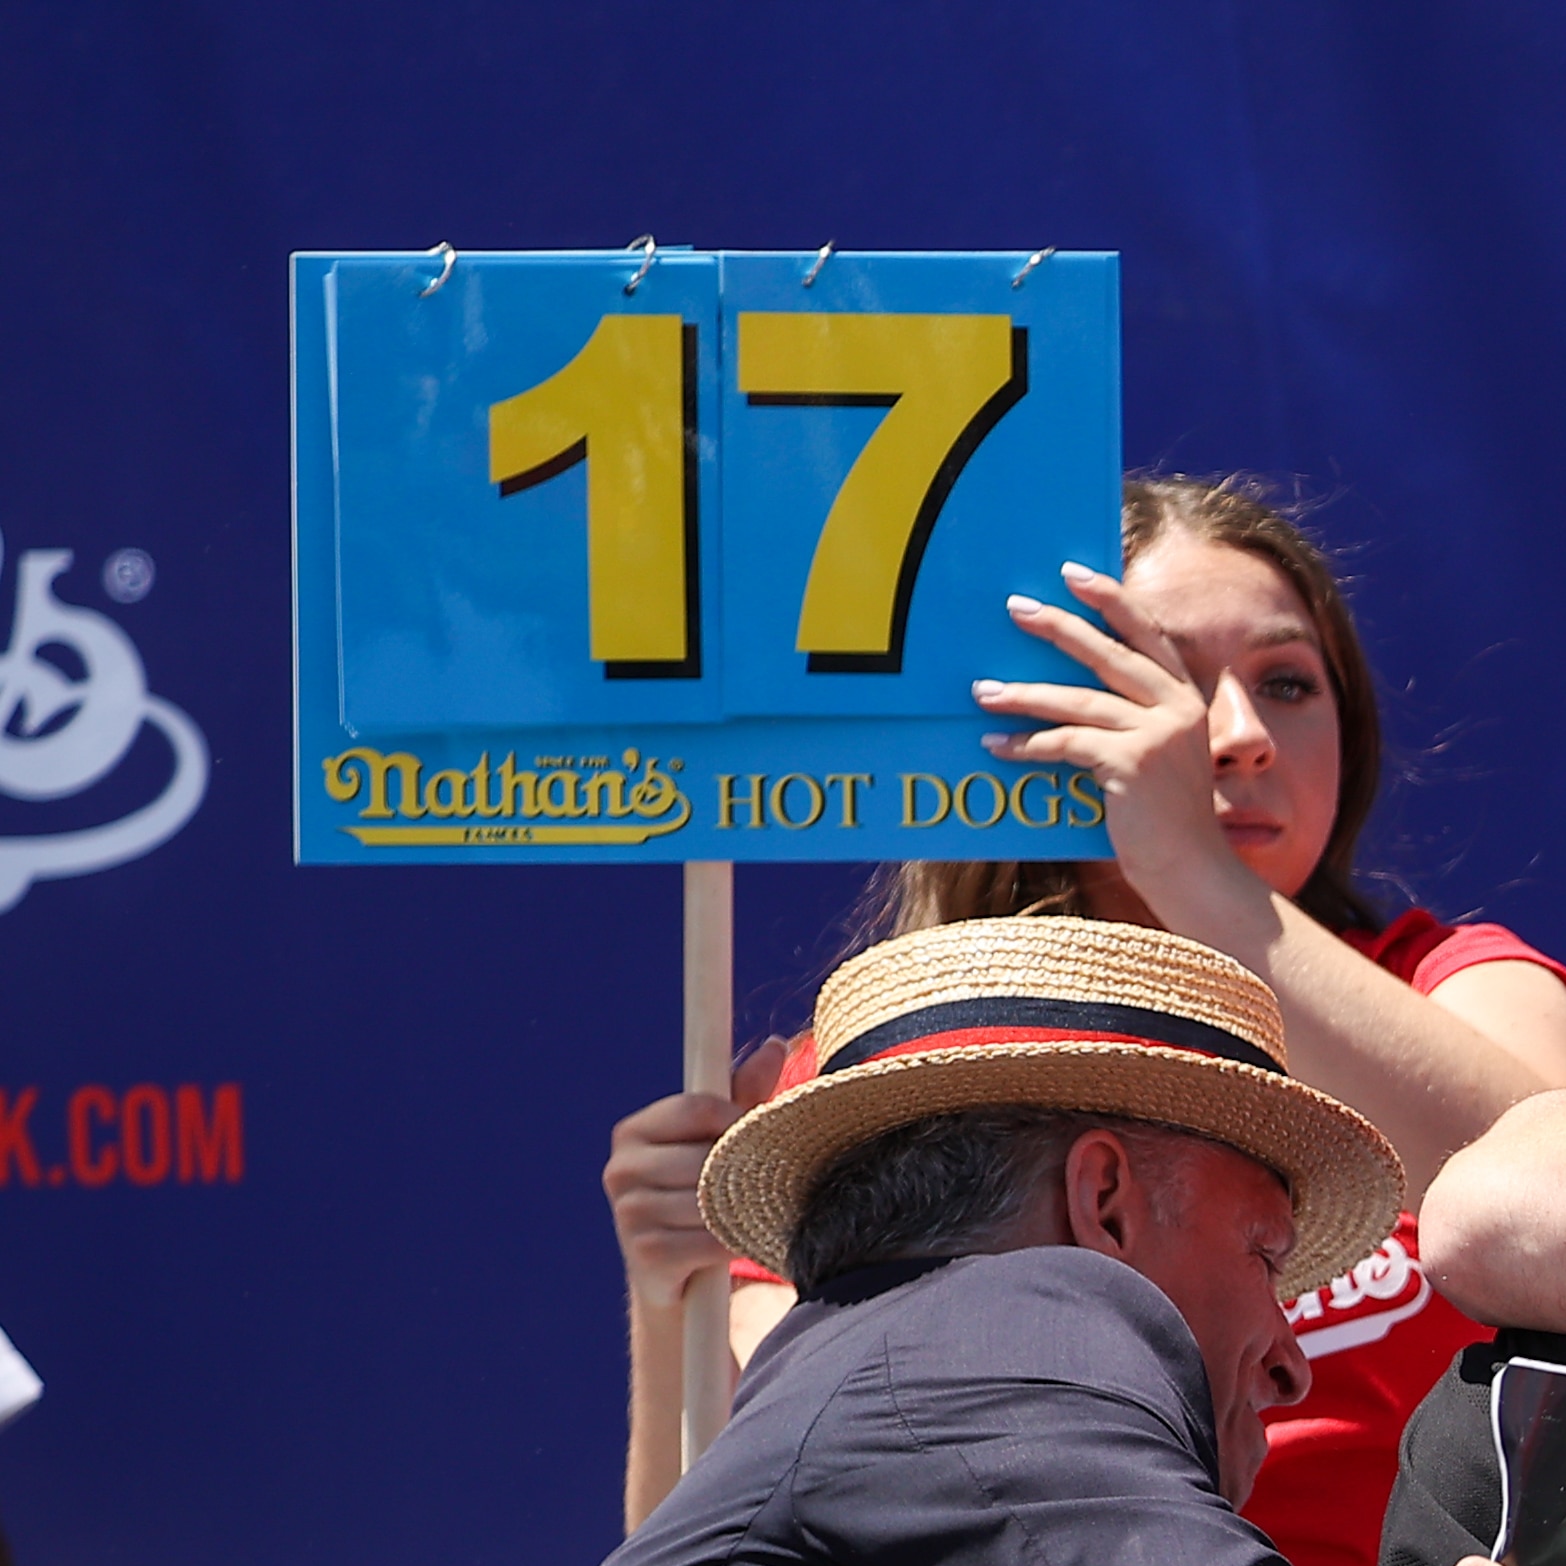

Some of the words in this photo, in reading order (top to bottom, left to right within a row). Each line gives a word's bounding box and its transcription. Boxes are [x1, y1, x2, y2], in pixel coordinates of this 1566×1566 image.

[489, 312, 1028, 678] 17
[321, 746, 692, 820] Nathan's
[715, 771, 874, 829] HOT
[899, 771, 1106, 829] DOGS
